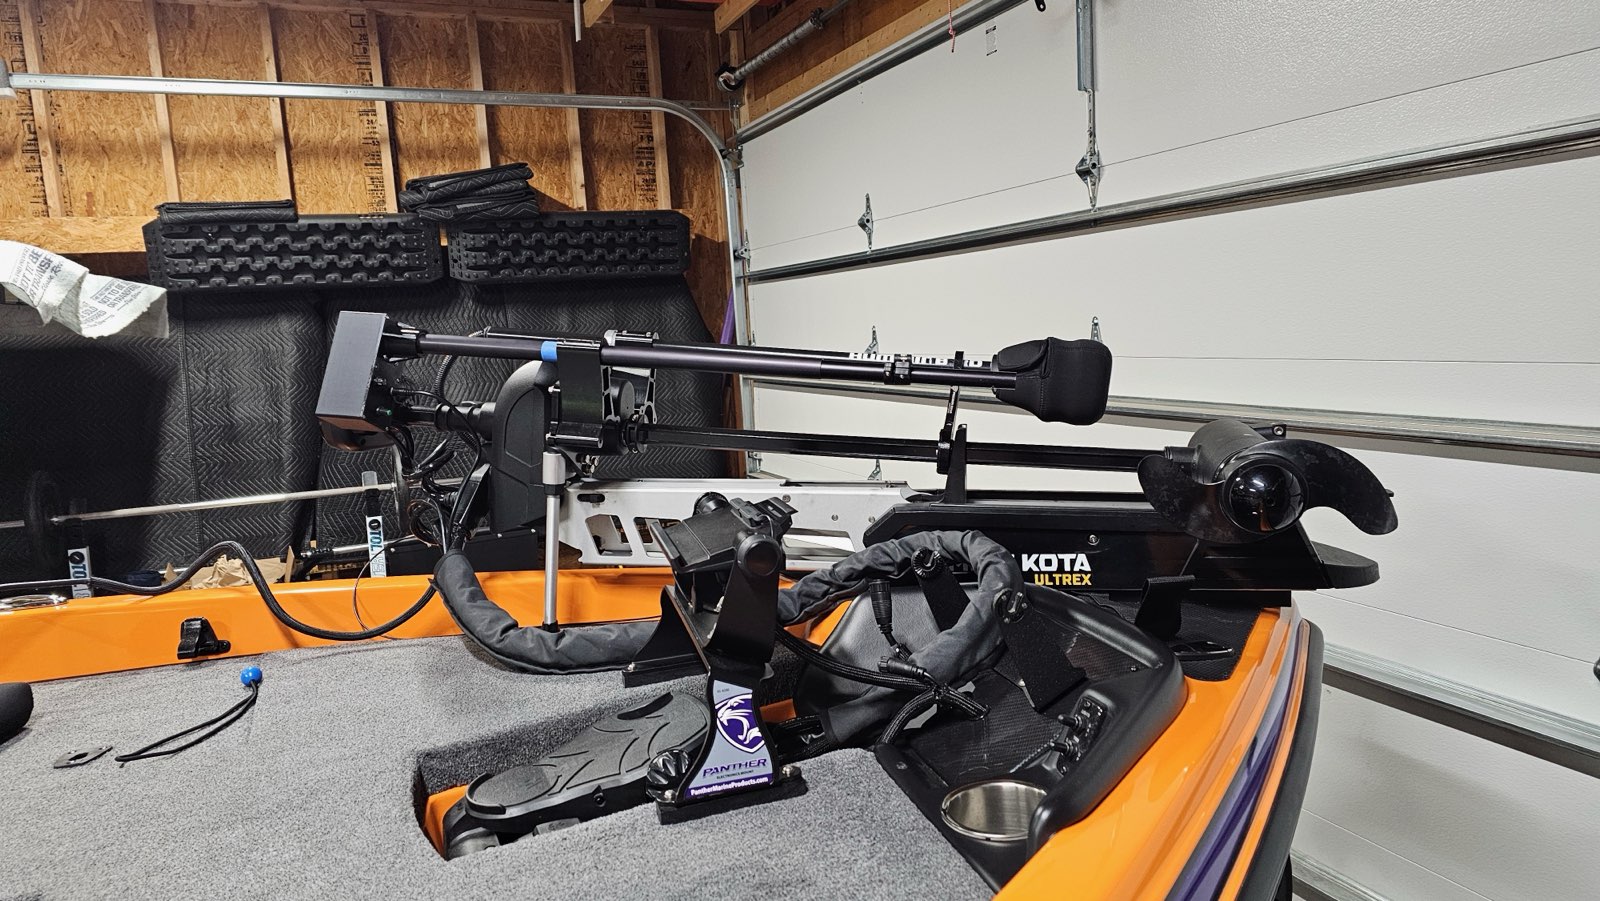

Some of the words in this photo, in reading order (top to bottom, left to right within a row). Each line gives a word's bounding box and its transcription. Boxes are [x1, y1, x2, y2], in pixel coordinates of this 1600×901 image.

[1021, 553, 1092, 572] KOTA
[1034, 573, 1092, 586] ULTREX
[702, 758, 767, 778] PANTHER
[690, 776, 769, 796] PantherMarineProducts.com
